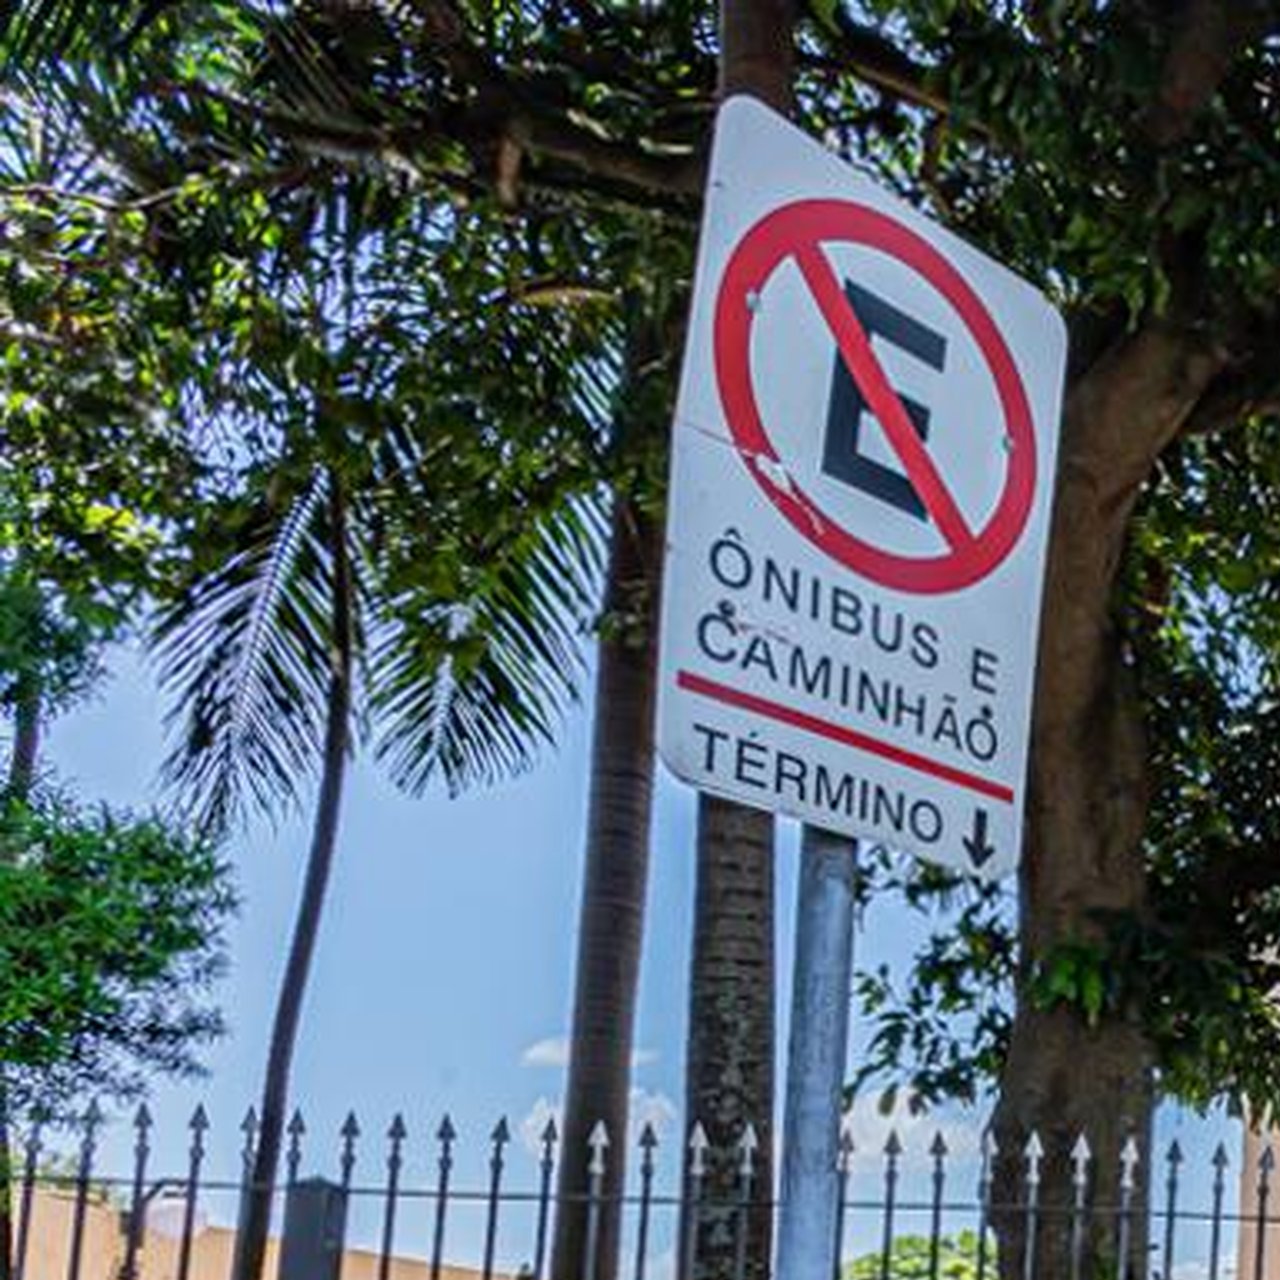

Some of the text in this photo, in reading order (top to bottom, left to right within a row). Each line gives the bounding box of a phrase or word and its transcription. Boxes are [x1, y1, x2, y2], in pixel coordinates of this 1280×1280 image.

[821, 277, 947, 524] E
[697, 612, 999, 763] CAMINHÃO
[709, 527, 999, 695] ÔNIBUS E
[693, 722, 943, 843] TÉRMINO
